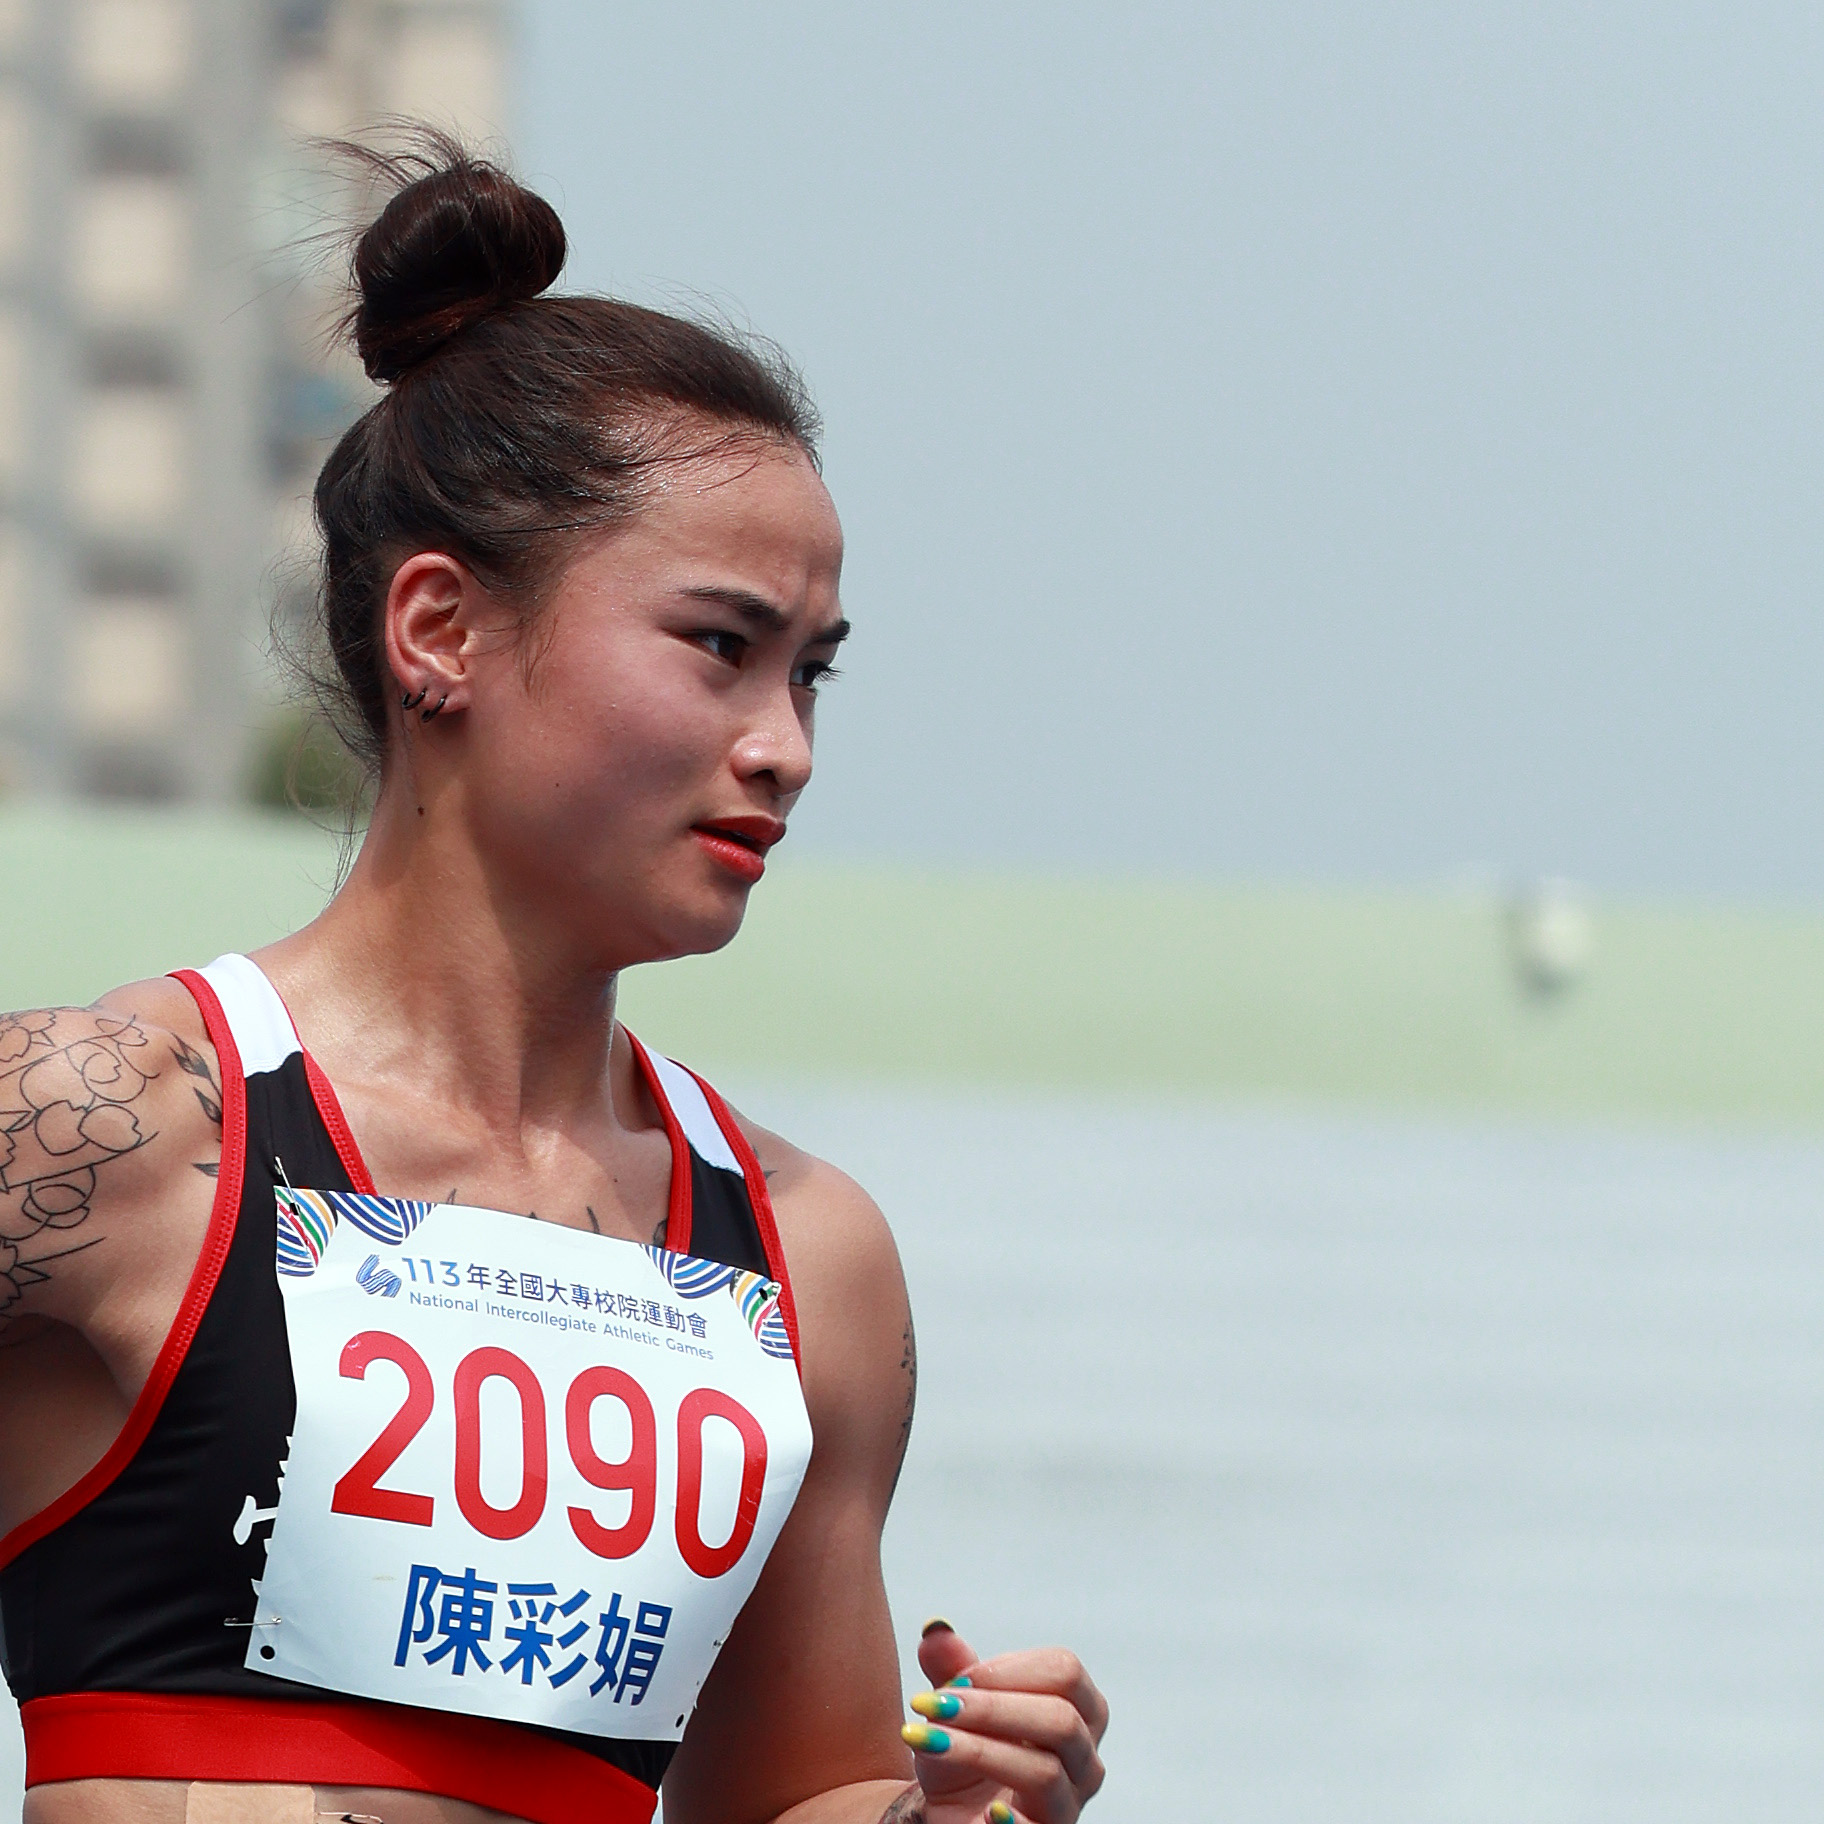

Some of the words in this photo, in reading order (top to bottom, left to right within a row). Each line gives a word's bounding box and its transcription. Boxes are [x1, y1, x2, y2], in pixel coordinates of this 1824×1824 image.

[401, 1257, 708, 1339] 113年全國大專校院運動會
[409, 1291, 479, 1312] National
[486, 1302, 597, 1333] Intercollegiate
[603, 1323, 661, 1347] Athletic
[665, 1337, 714, 1361] Games
[330, 1330, 769, 1580] 2090
[394, 1563, 674, 1707] 陳彩娟
